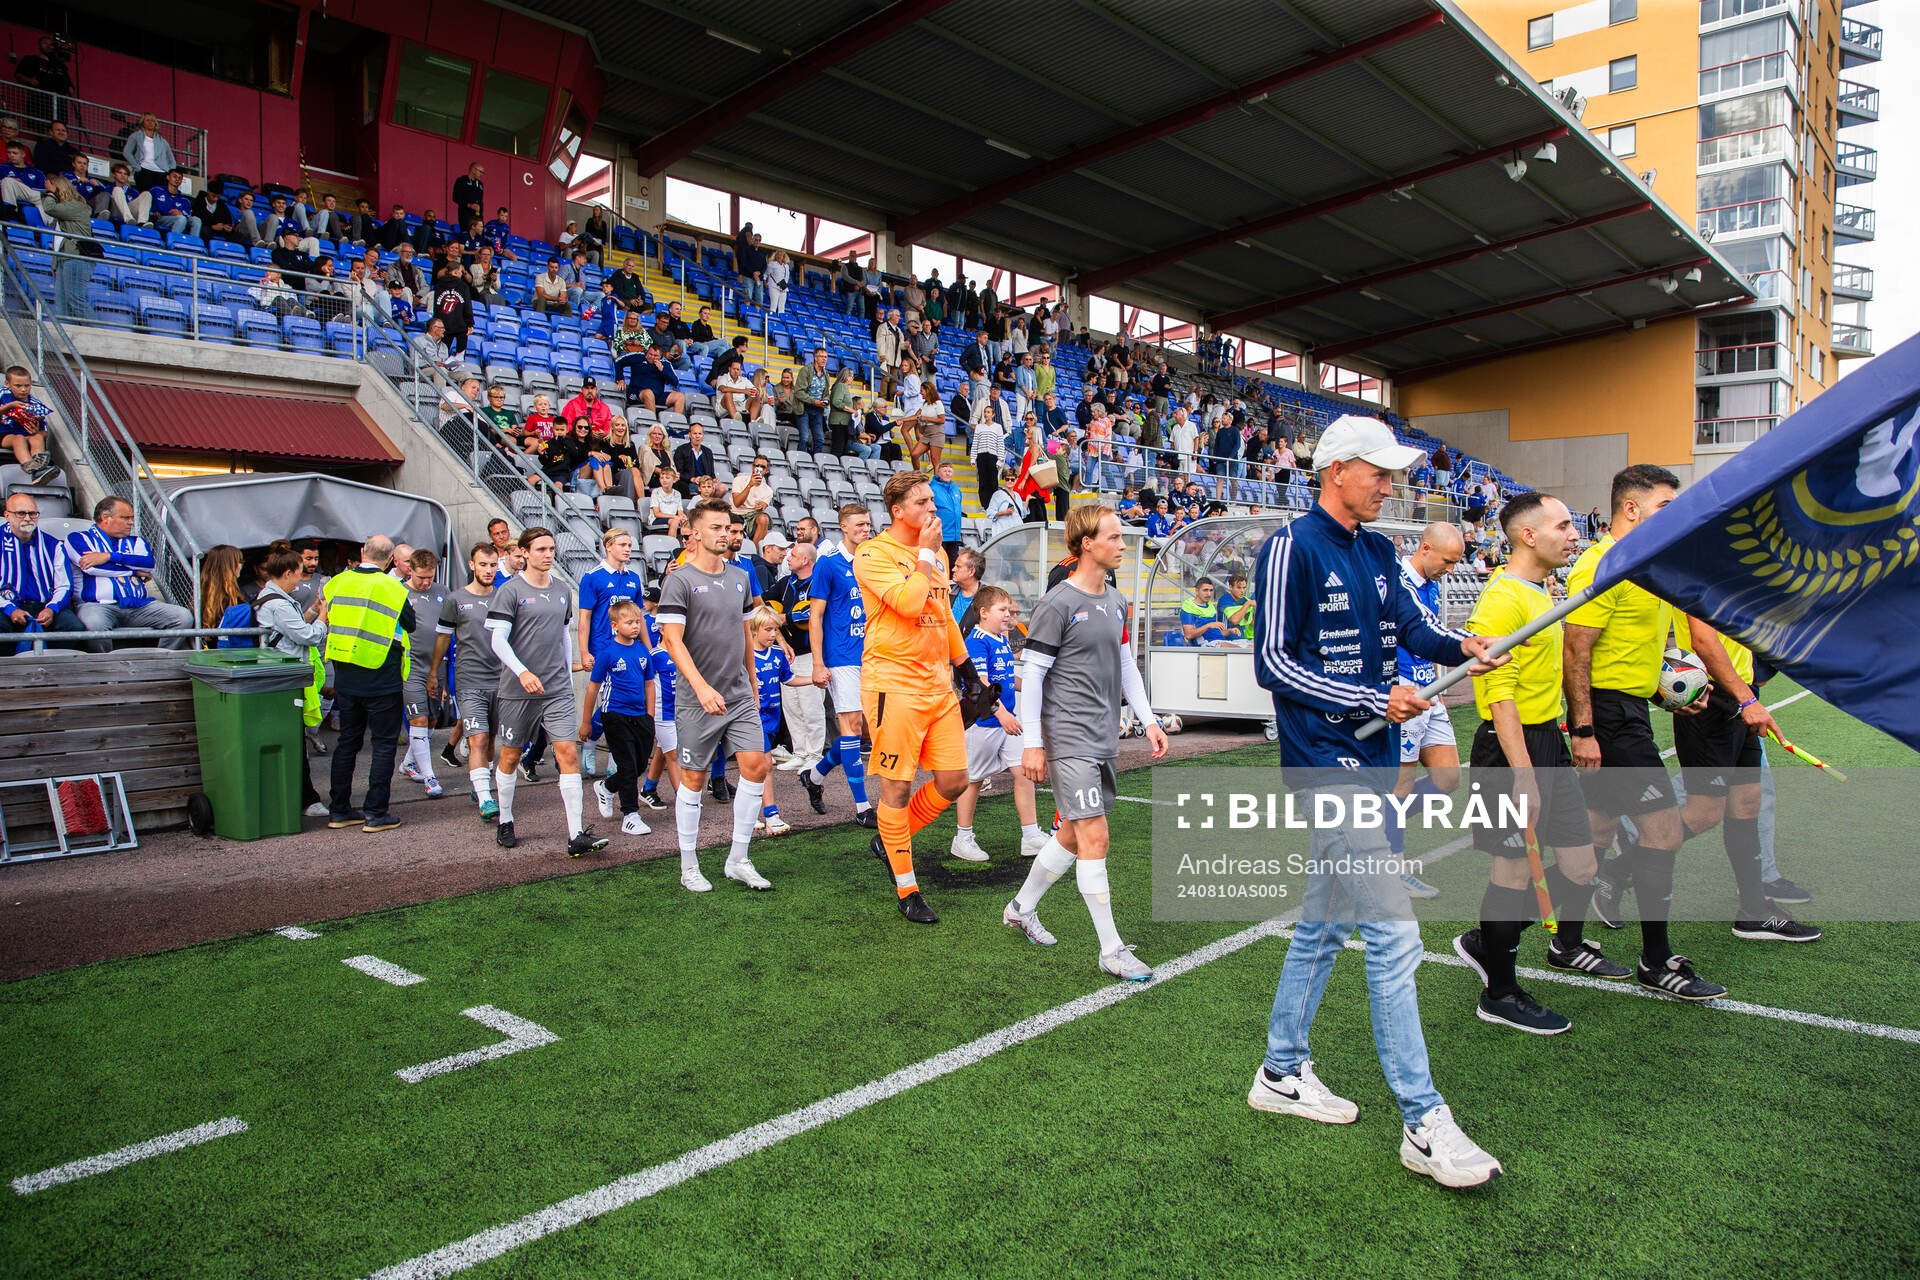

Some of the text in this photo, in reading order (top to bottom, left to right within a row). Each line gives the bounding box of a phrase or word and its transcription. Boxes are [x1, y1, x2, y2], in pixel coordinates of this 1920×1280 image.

[523, 172, 534, 186] C
[640, 186, 649, 197] C
[1328, 593, 1348, 603] TEAM
[1319, 602, 1350, 613] SPORTIA
[406, 703, 419, 716] 11
[463, 717, 480, 730] 34
[501, 725, 514, 741] 16
[682, 747, 691, 764] 5
[880, 751, 899, 770] 27
[1337, 757, 1361, 772] TP
[1075, 786, 1100, 810] 10
